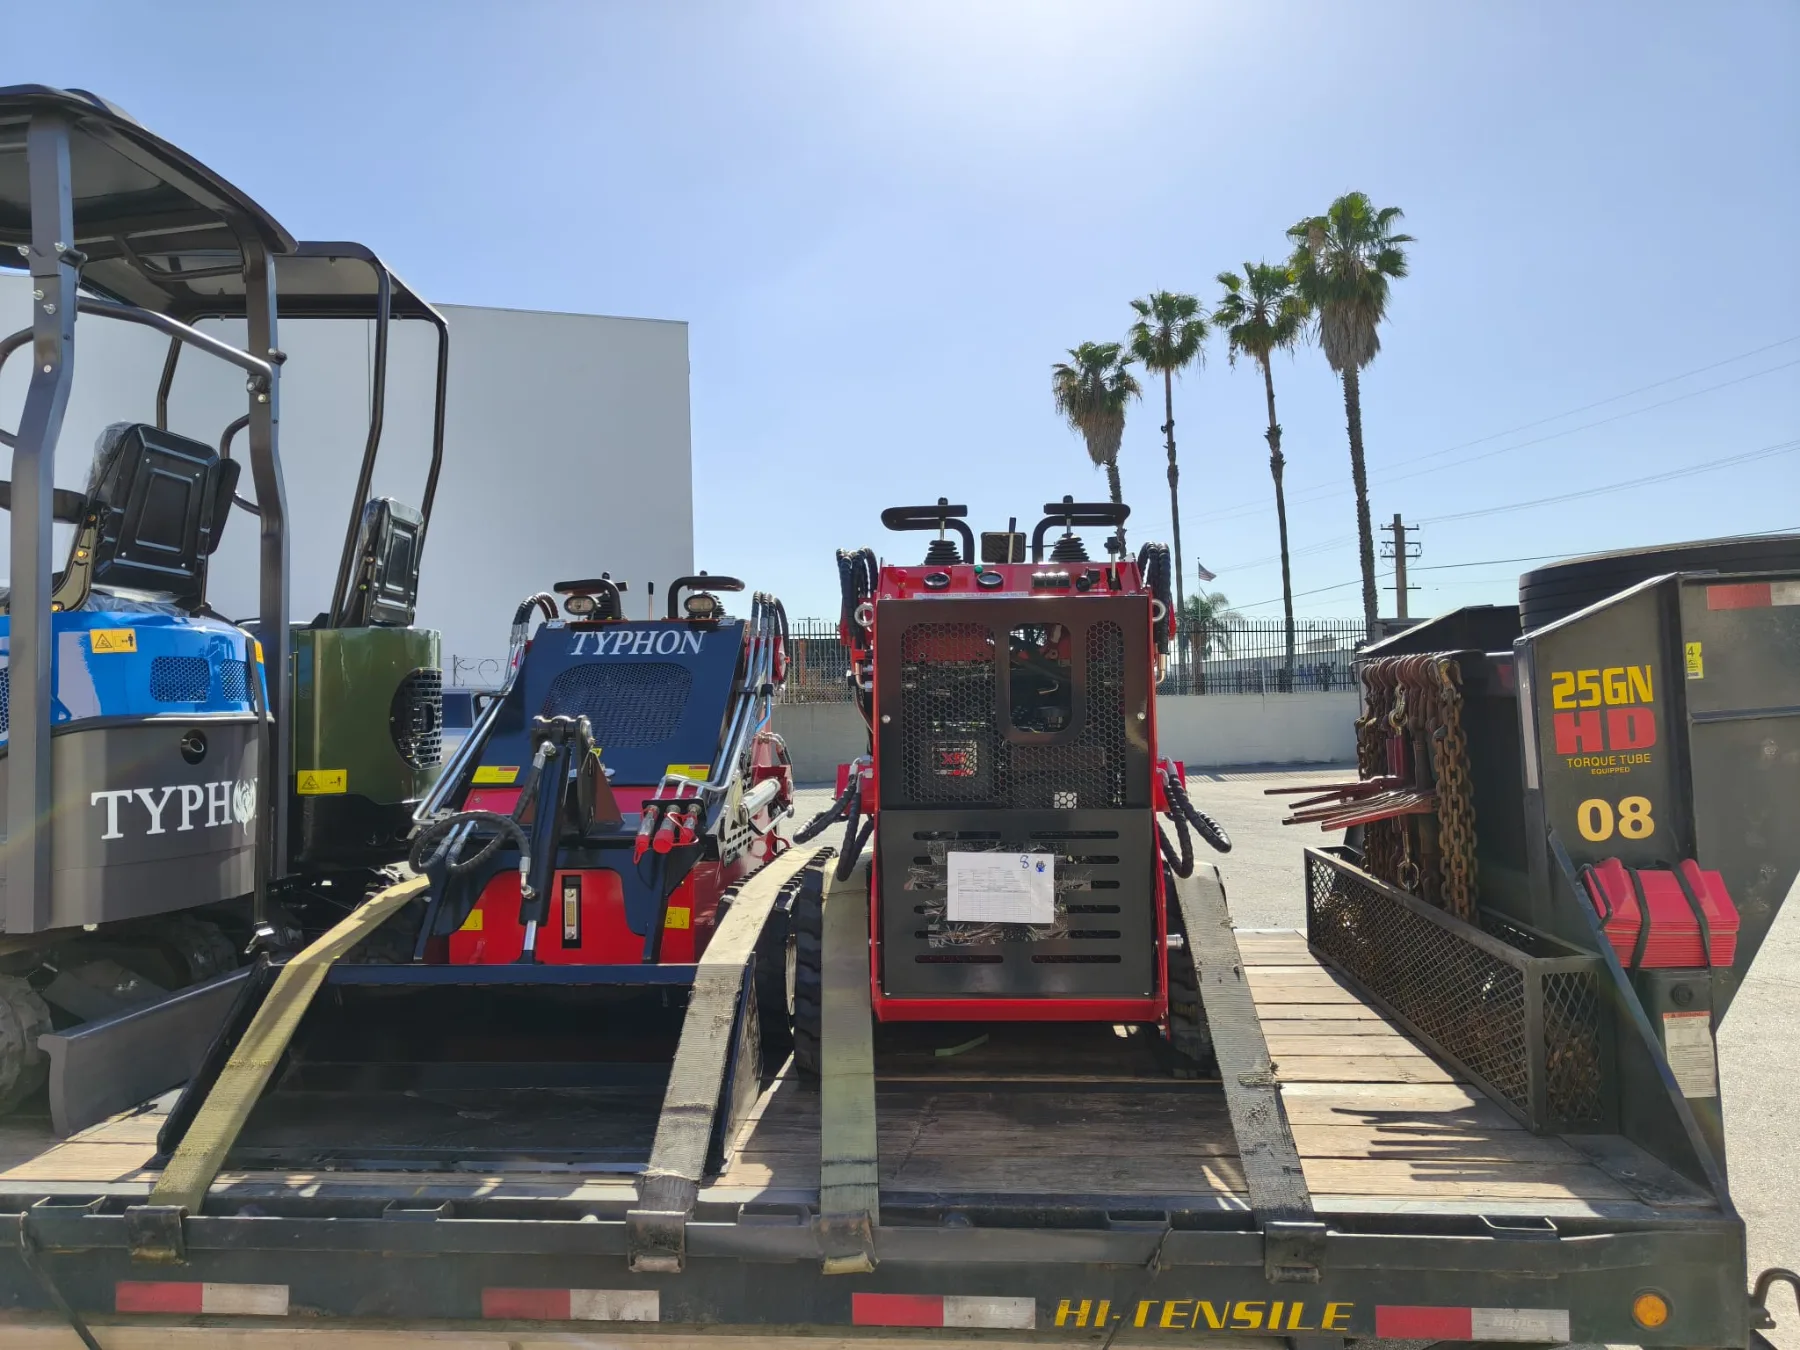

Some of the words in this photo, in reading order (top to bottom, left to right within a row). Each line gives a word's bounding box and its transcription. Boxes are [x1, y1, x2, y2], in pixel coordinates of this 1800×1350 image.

[570, 630, 707, 656] TYPHON
[1551, 664, 1654, 710] 25GN
[1553, 706, 1657, 755] HD
[1566, 755, 1617, 769] TORQUE
[1619, 752, 1653, 765] TUBE
[1591, 766, 1631, 775] EQUIPPED
[1577, 795, 1655, 842] 08
[1054, 1298, 1355, 1331] HI-TENSILE
